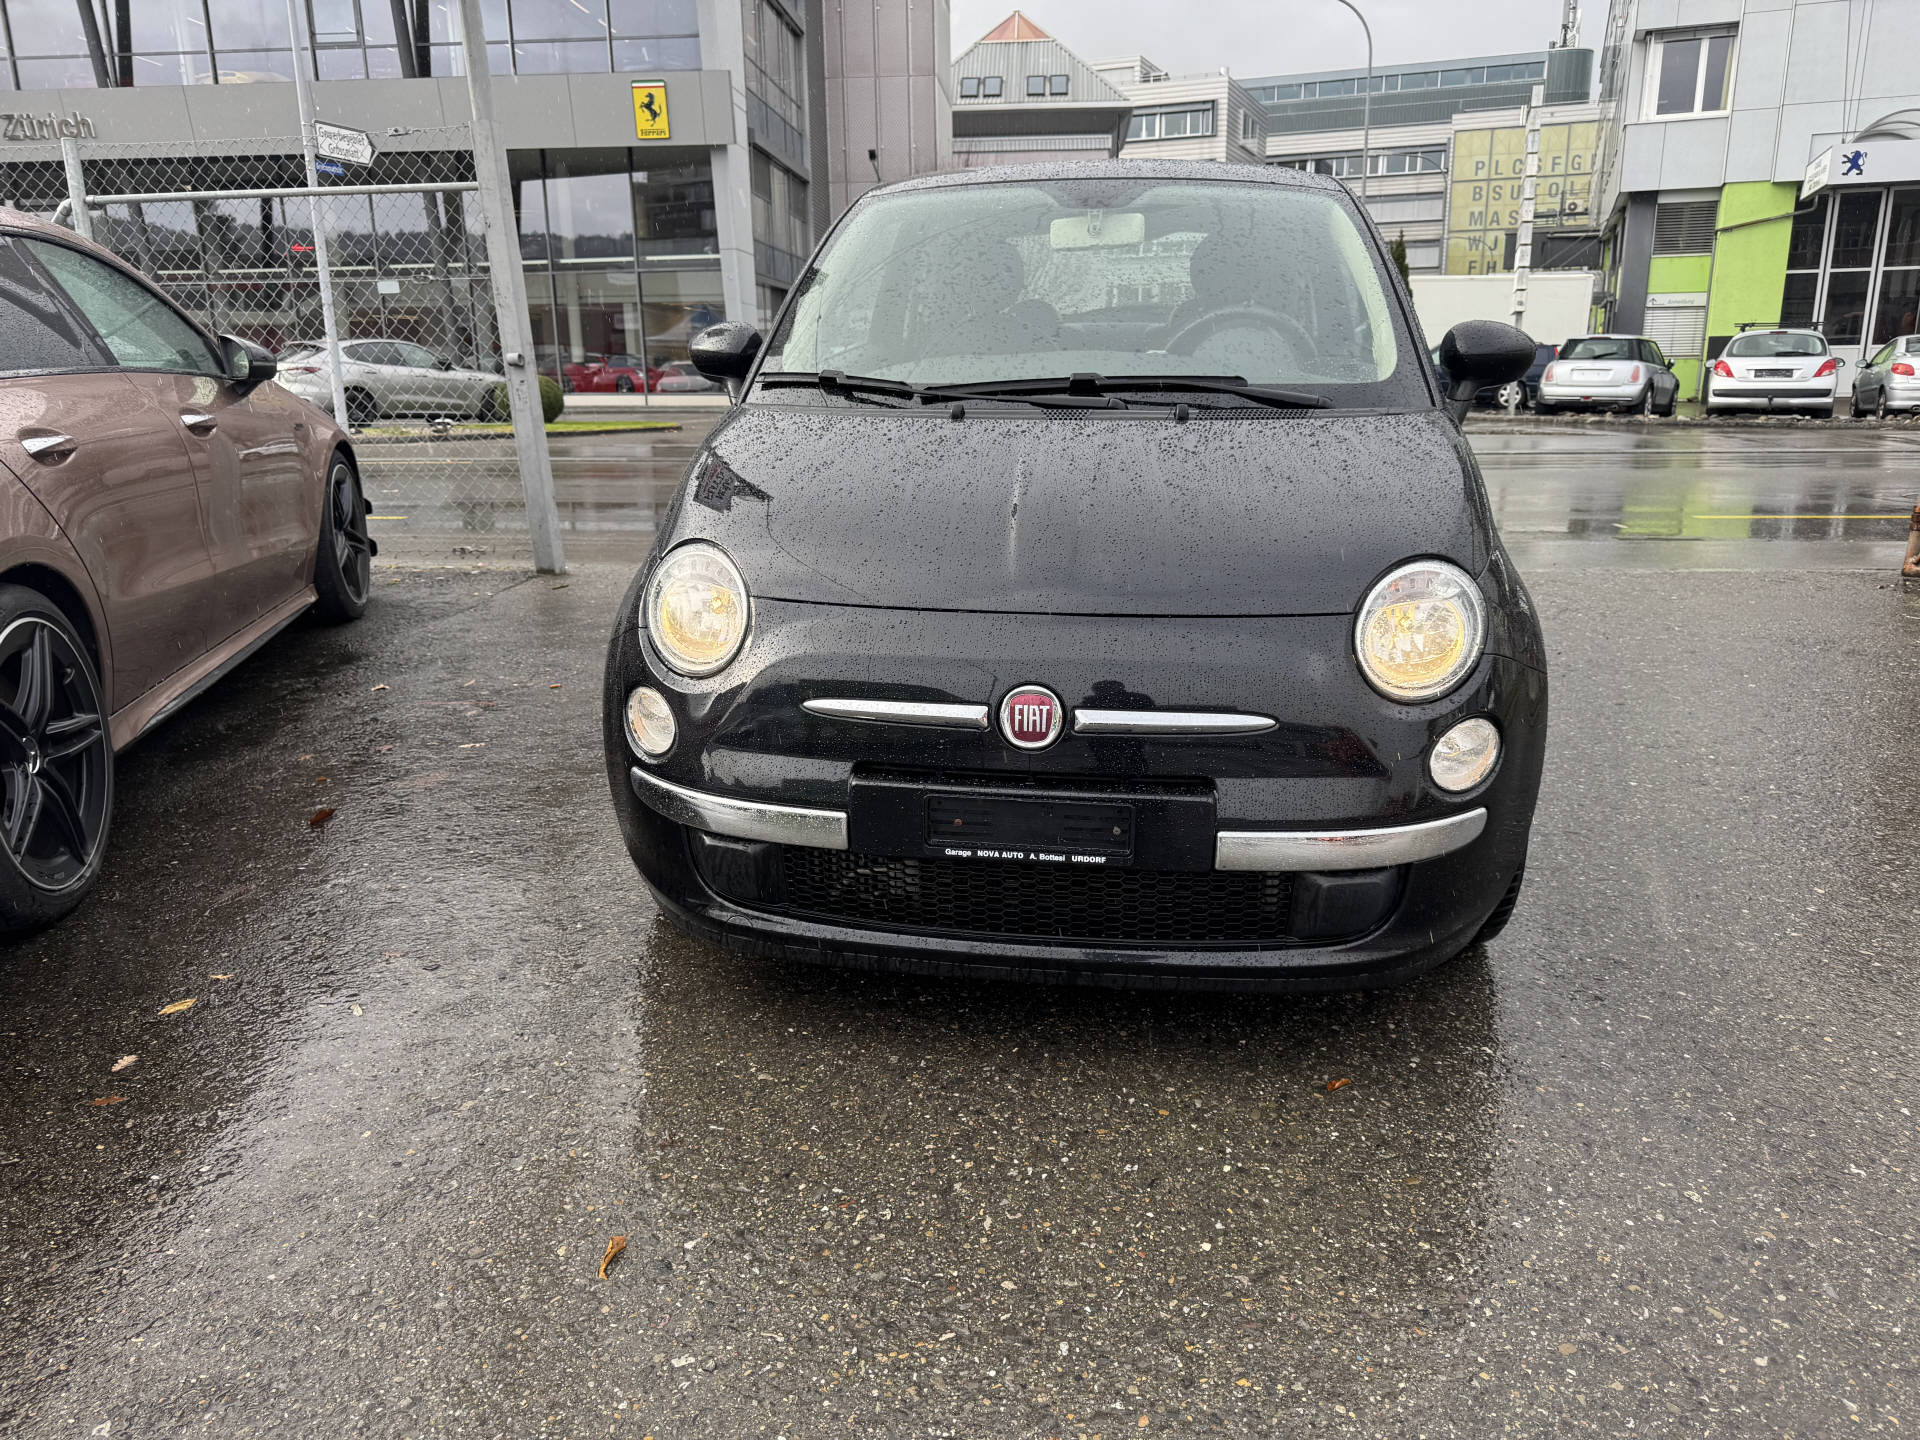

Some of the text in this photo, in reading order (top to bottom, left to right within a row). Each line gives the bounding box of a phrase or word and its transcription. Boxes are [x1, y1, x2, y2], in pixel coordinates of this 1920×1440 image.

[0, 111, 97, 140] Zürich
[640, 128, 666, 137] Ferrari
[1014, 704, 1050, 733] FIAT
[945, 848, 972, 857] Garage
[977, 850, 1000, 858] NOVA
[1001, 851, 1024, 859] AUTO
[1071, 855, 1107, 864] URDORF
